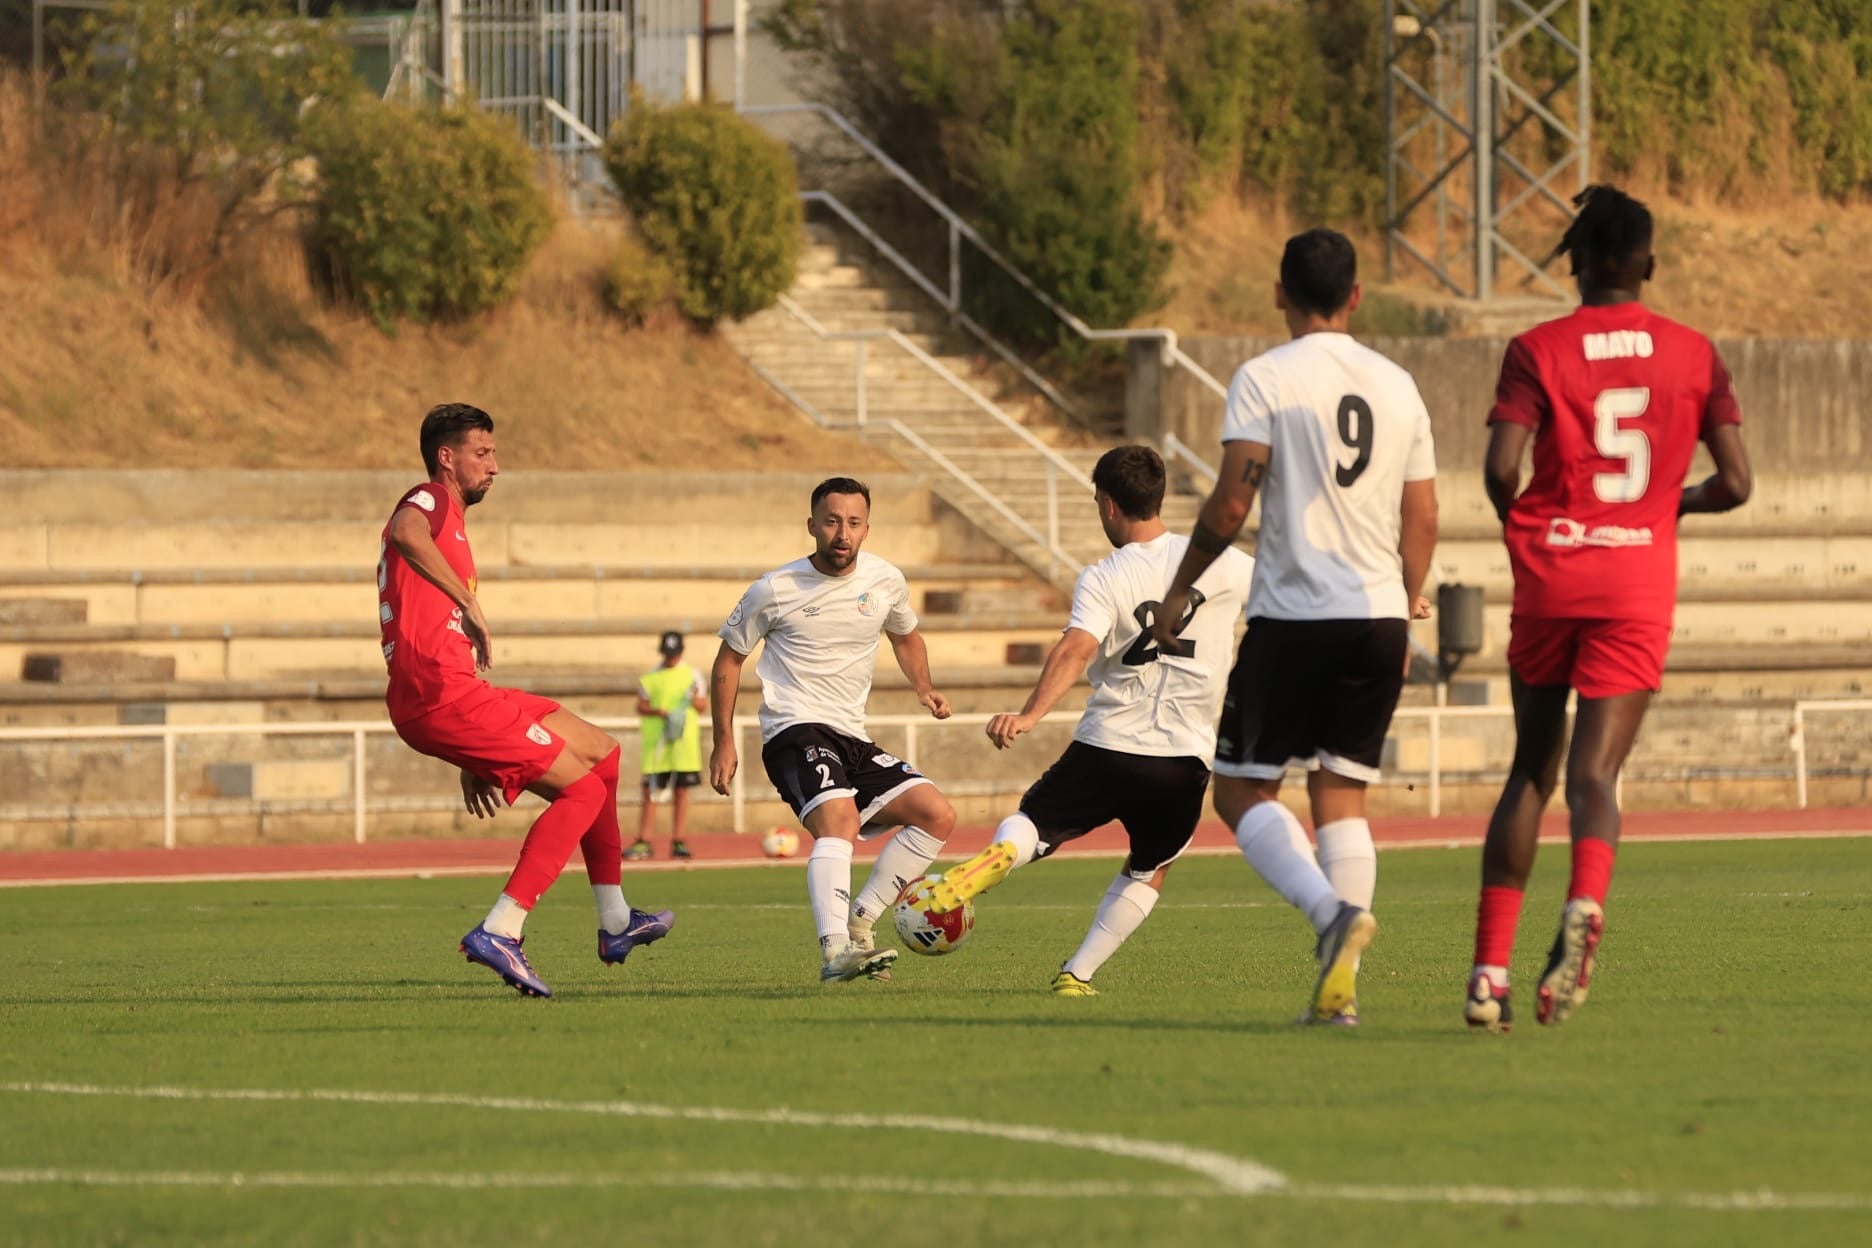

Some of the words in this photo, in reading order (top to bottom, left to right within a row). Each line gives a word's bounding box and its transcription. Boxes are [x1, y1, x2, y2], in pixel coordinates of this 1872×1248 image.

[1582, 330, 1654, 361] MAYO
[1336, 395, 1374, 488] 9
[1593, 387, 1651, 503] 5
[1122, 586, 1206, 665] 22
[816, 764, 835, 789] 2
